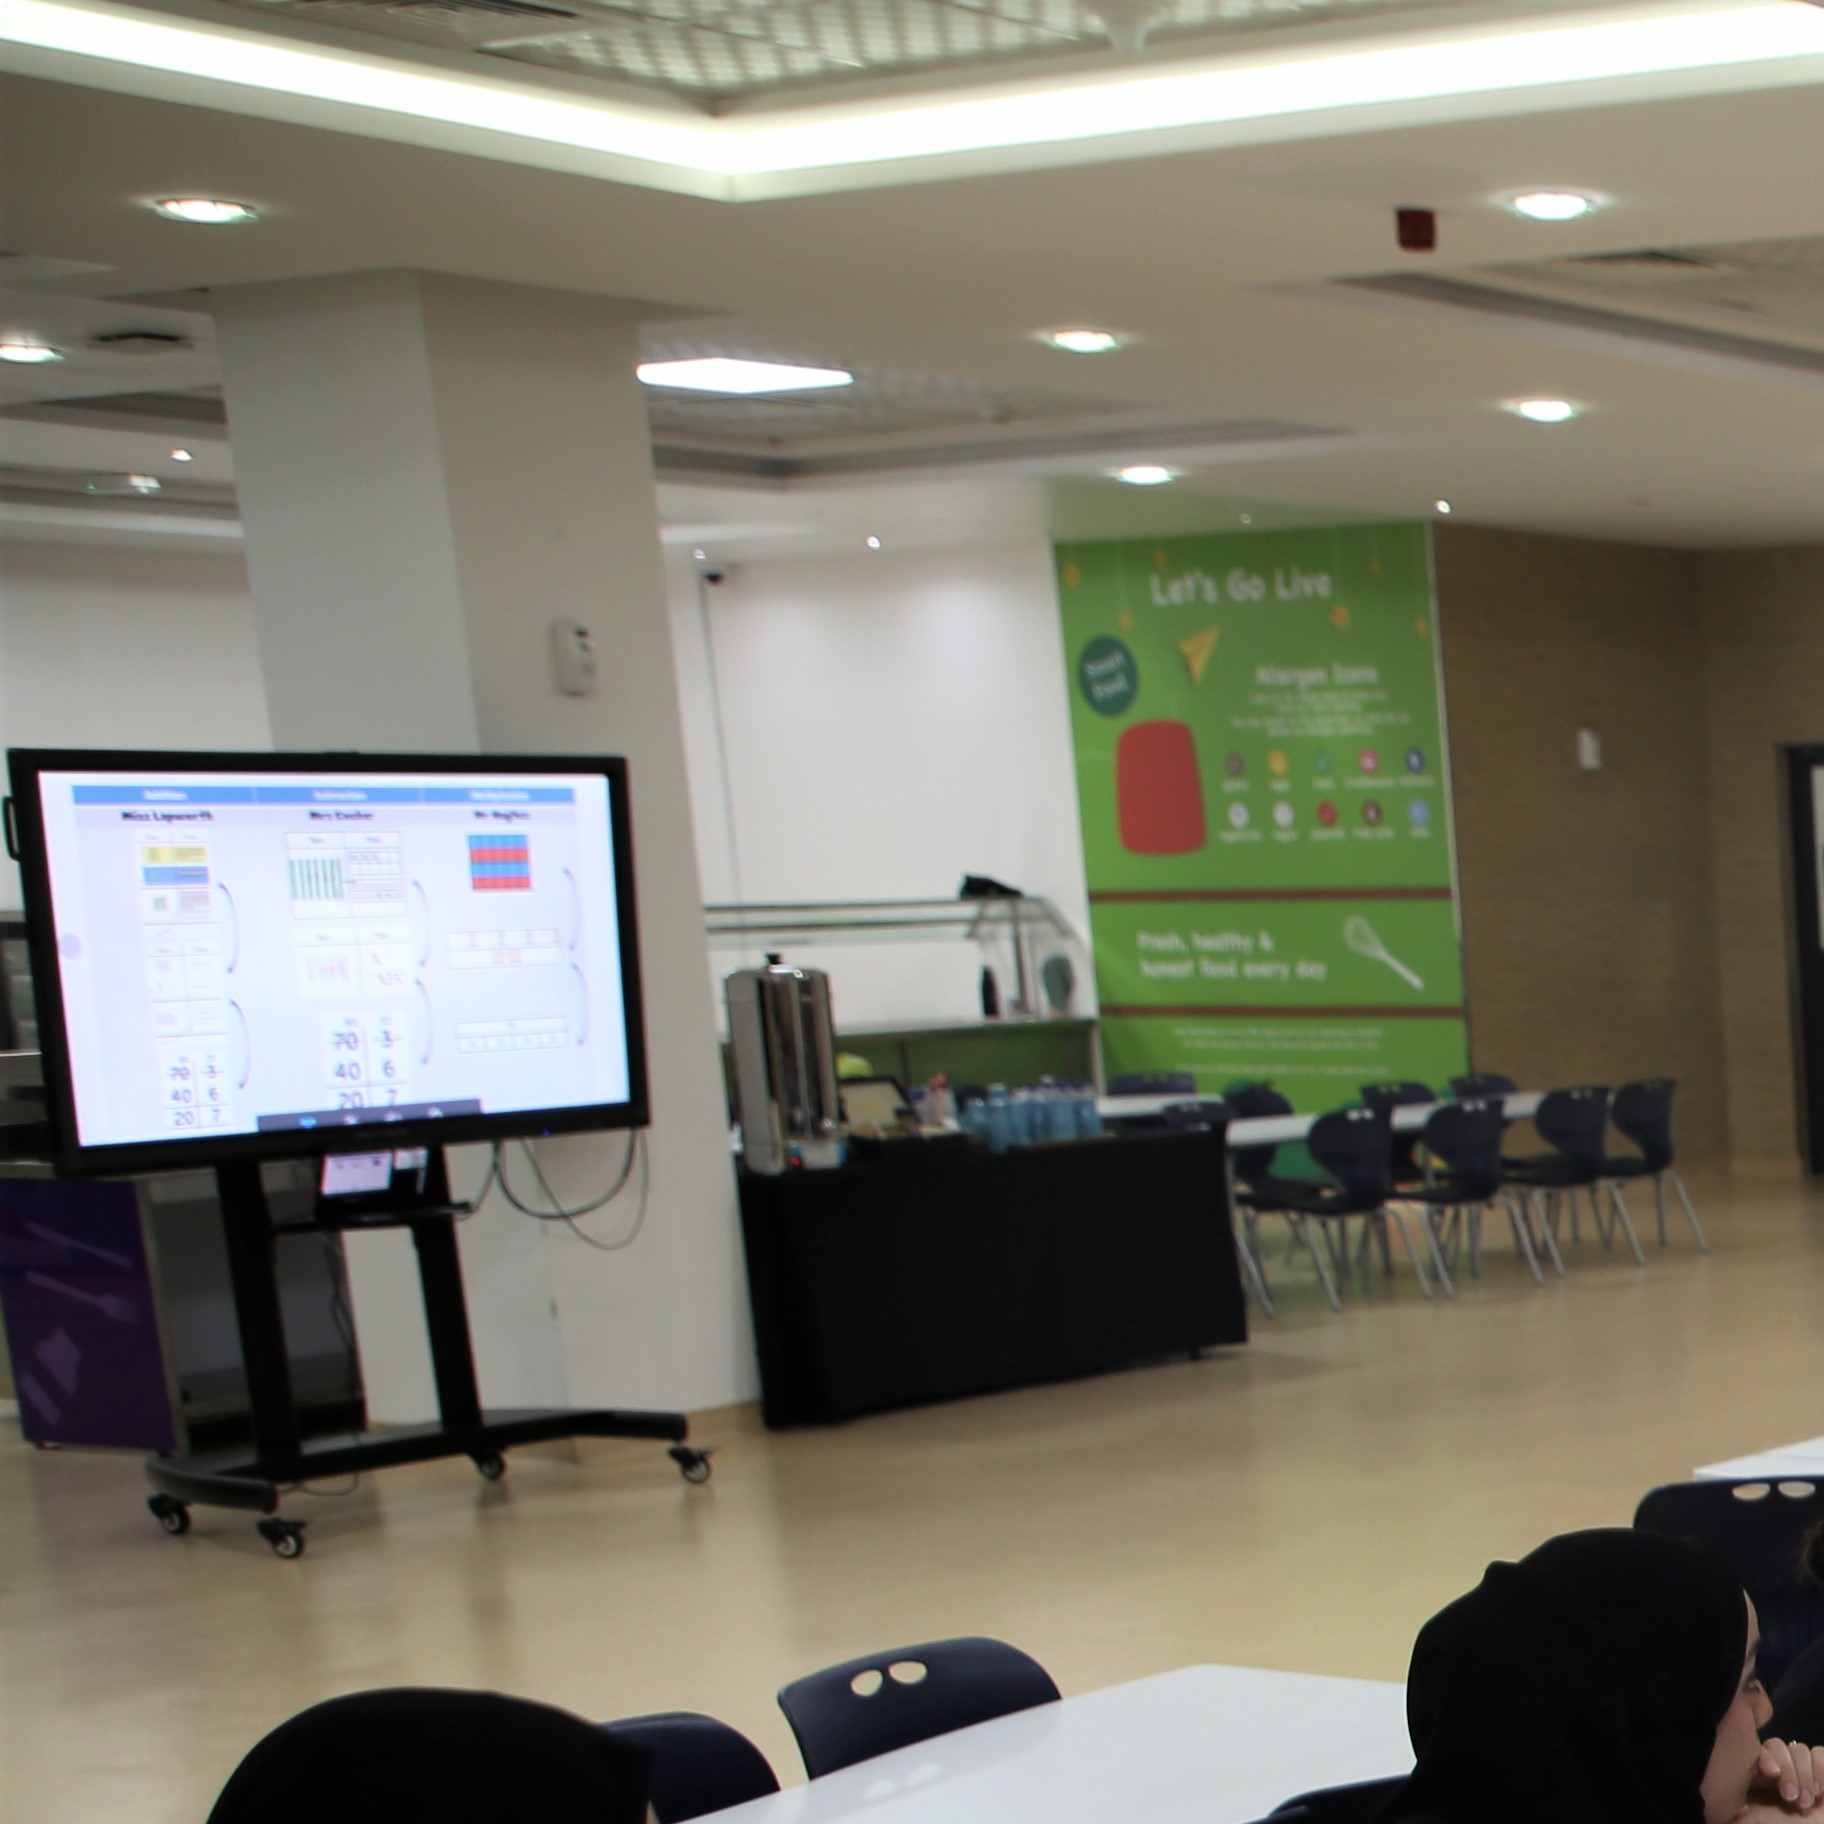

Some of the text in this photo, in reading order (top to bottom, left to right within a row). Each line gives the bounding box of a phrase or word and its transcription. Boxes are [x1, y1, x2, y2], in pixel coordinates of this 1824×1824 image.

[1151, 563, 1332, 606] Let's Go Live
[335, 1060, 396, 1080] 40 6
